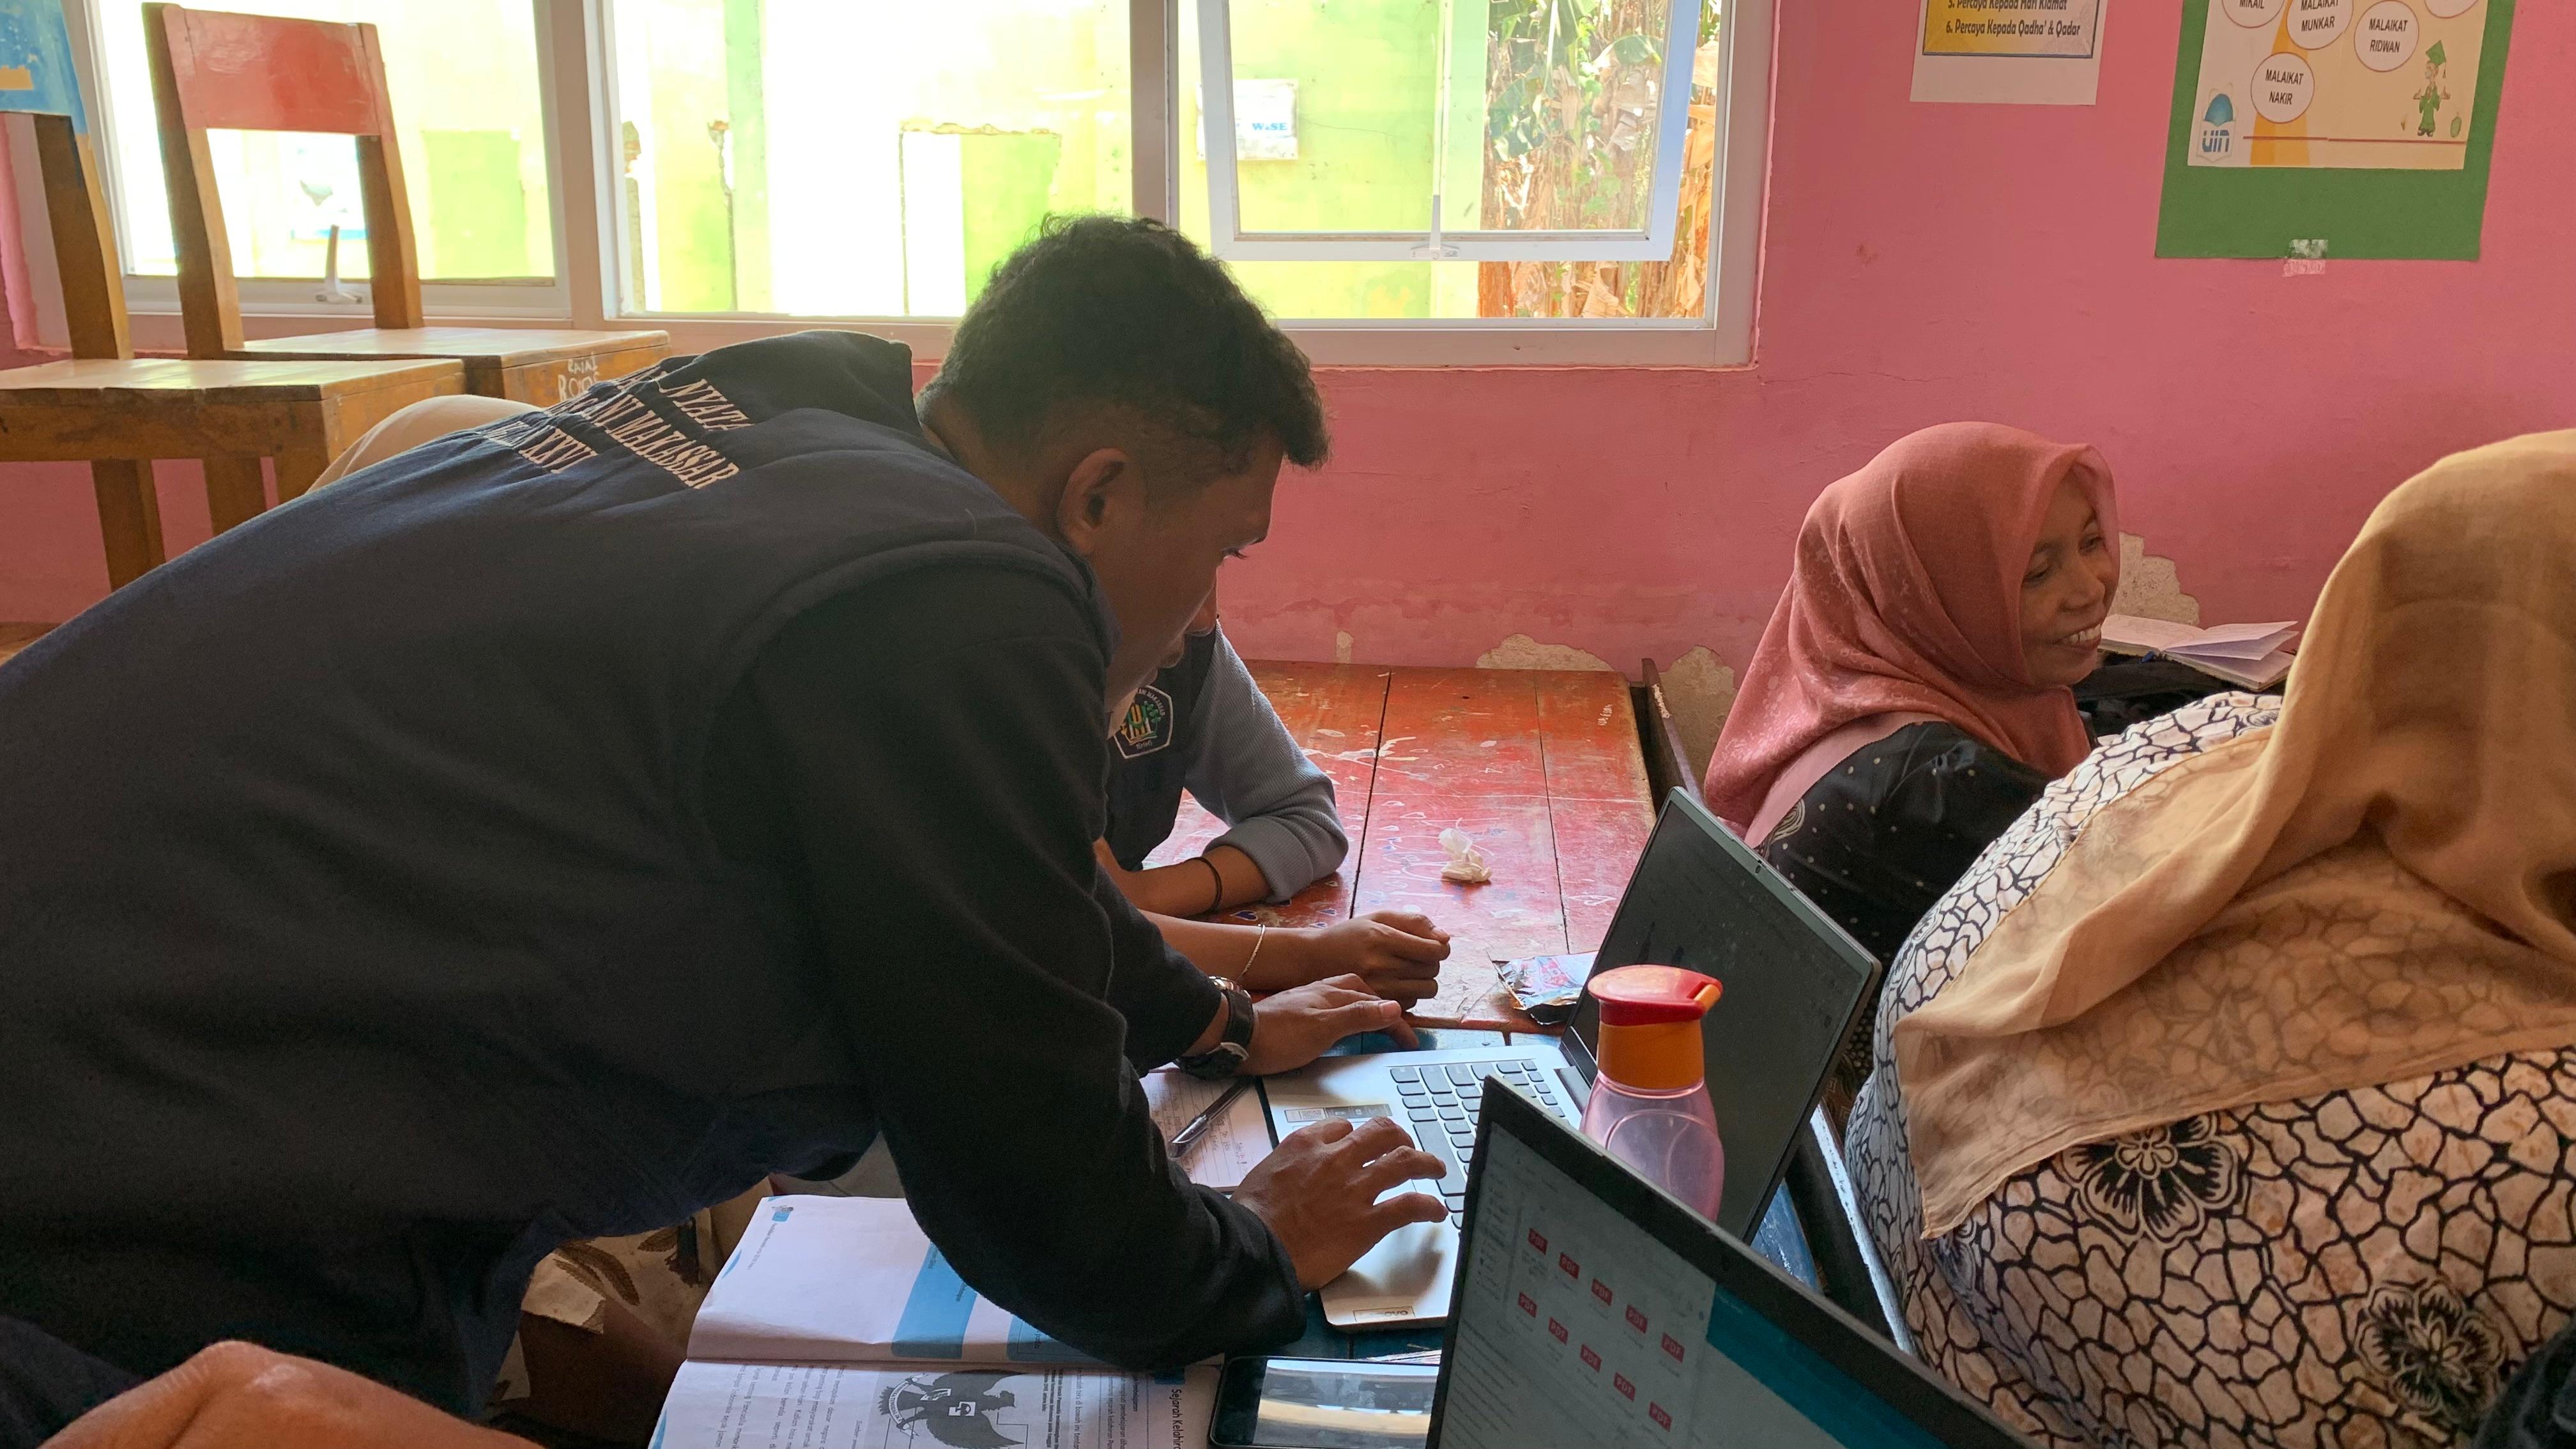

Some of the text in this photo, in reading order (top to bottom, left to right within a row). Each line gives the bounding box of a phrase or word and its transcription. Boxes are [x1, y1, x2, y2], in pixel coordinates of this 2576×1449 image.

[1957, 0, 1987, 12] Percaya
[1989, 0, 2018, 12] Kepada
[1955, 19, 1985, 37] Percaya
[1987, 19, 2016, 37] Kepada
[2018, 19, 2046, 37] Qadha'
[2048, 20, 2053, 34] &
[2056, 20, 2080, 37] Qadar
[2301, 16, 2335, 31] MUNKAR
[2369, 19, 2408, 32] MALAIKAT
[2370, 40, 2400, 52] RIDWAN
[2266, 69, 2304, 86] MALAIKAT
[2269, 91, 2292, 105] NAKIR
[659, 378, 755, 431] NYATA
[604, 410, 740, 489] MAKASSAR
[1170, 1389, 1182, 1418] Sejarah
